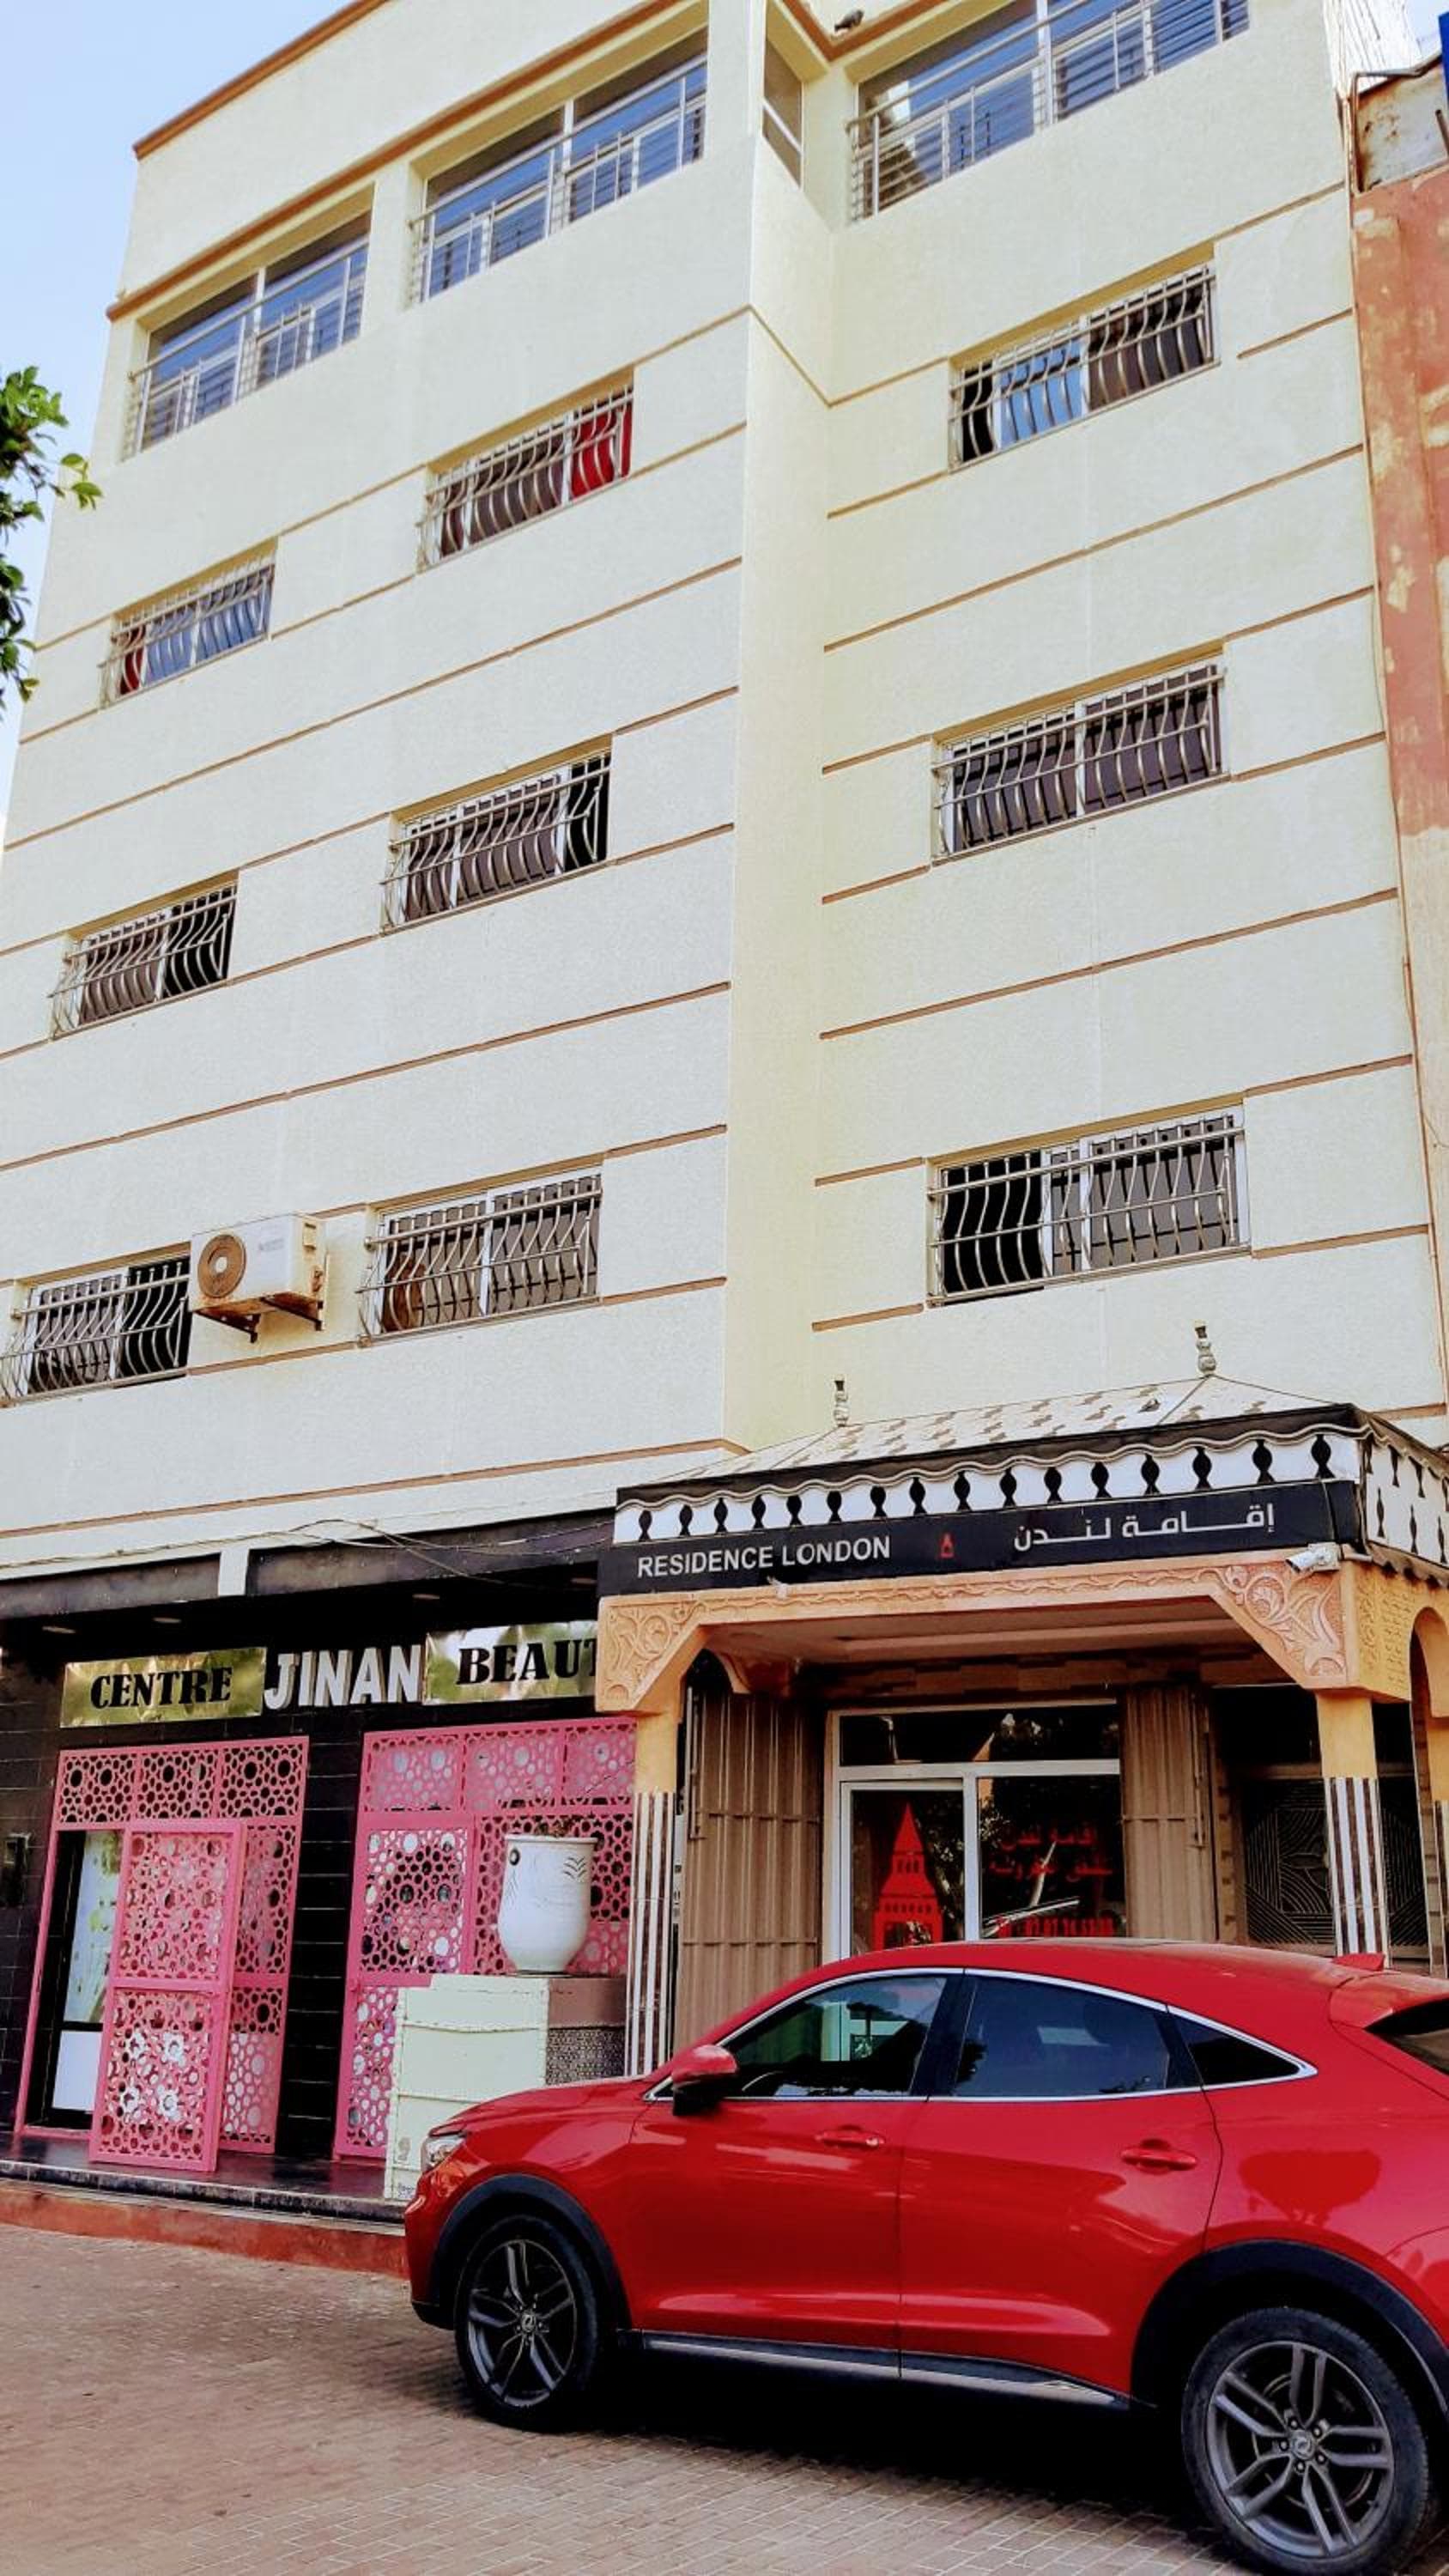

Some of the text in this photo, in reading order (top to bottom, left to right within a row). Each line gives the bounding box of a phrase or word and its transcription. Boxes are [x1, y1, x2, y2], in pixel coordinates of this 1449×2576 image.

[1014, 1517, 1111, 1551] لندن
[638, 1535, 890, 1578] RESIDENCE LONDON
[91, 1667, 233, 1709] CENTRE
[264, 1645, 422, 1710] JINAN
